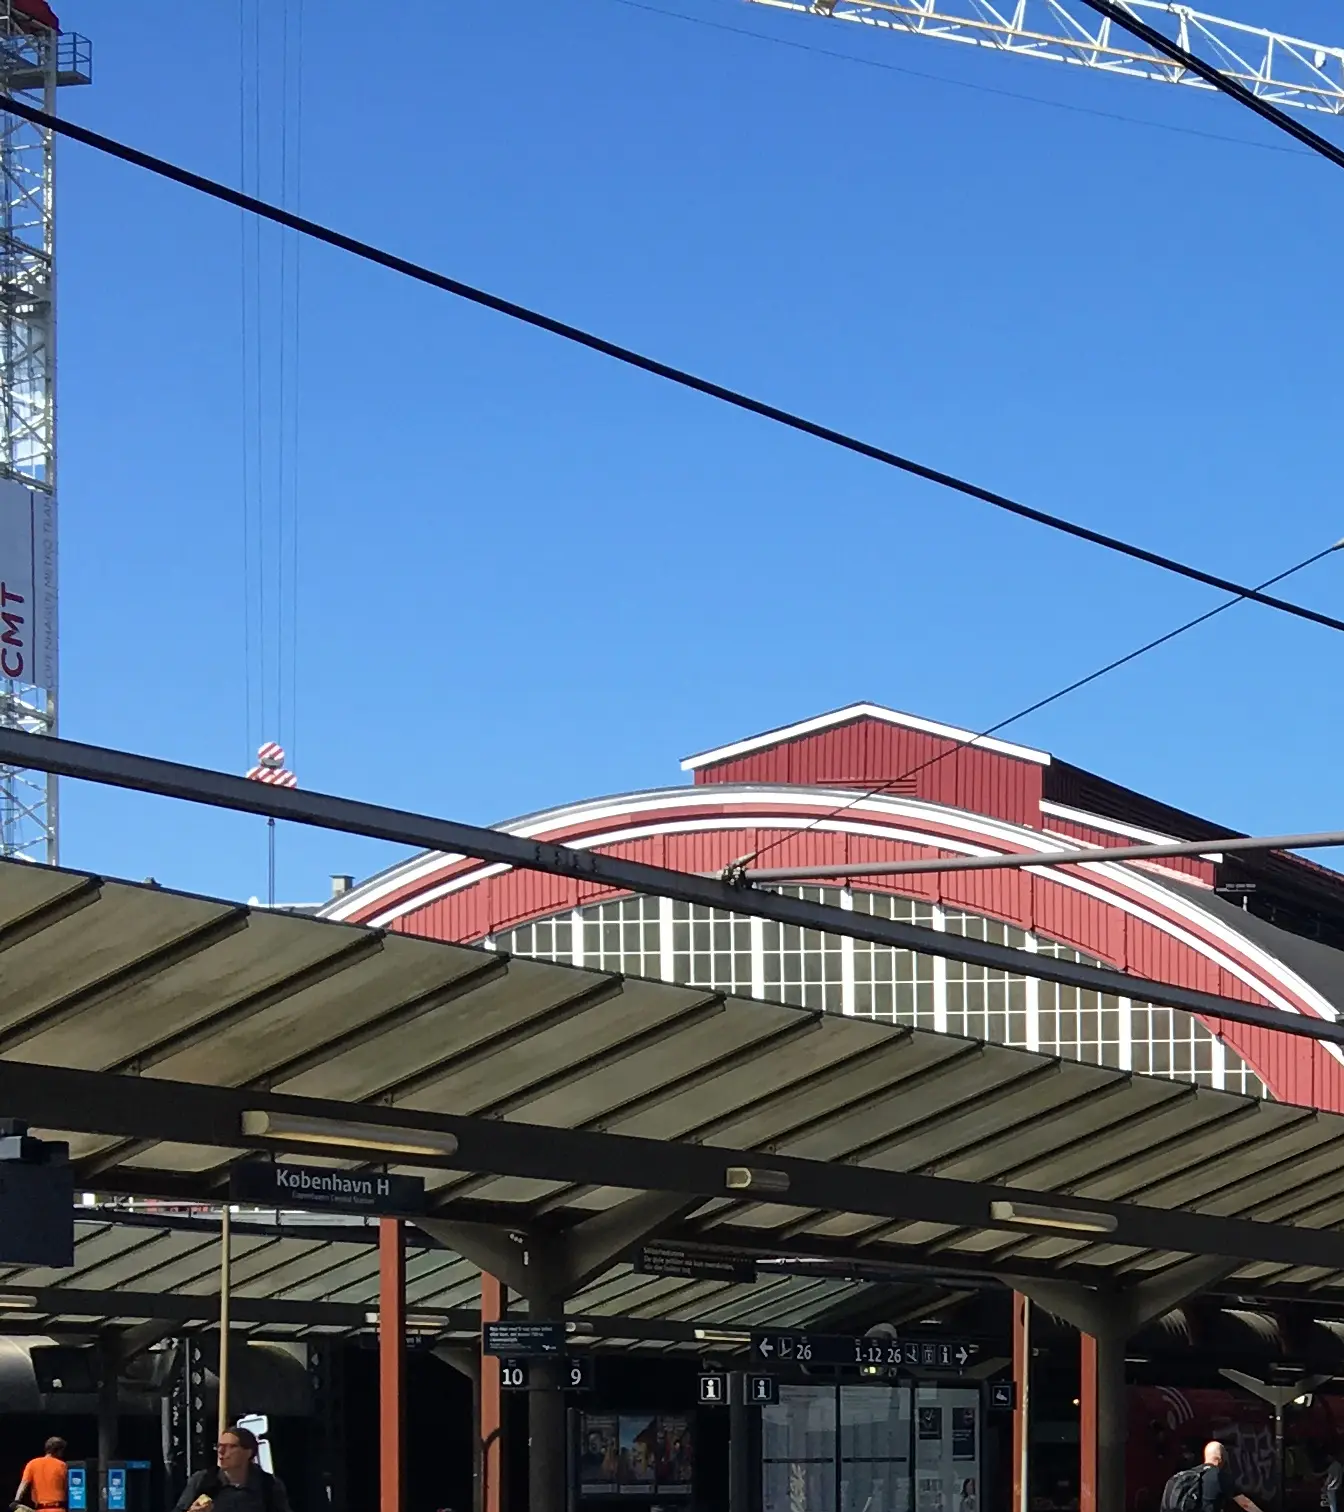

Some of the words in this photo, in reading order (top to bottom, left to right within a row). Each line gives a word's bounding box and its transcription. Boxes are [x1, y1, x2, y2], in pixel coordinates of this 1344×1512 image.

[1, 581, 25, 678] CMT
[276, 1169, 371, 1195] København
[376, 1179, 390, 1195] H
[796, 1344, 812, 1360] 26
[854, 1347, 882, 1363] 1-12
[887, 1348, 902, 1364] 26
[502, 1368, 524, 1386] 10
[571, 1368, 582, 1386] 9
